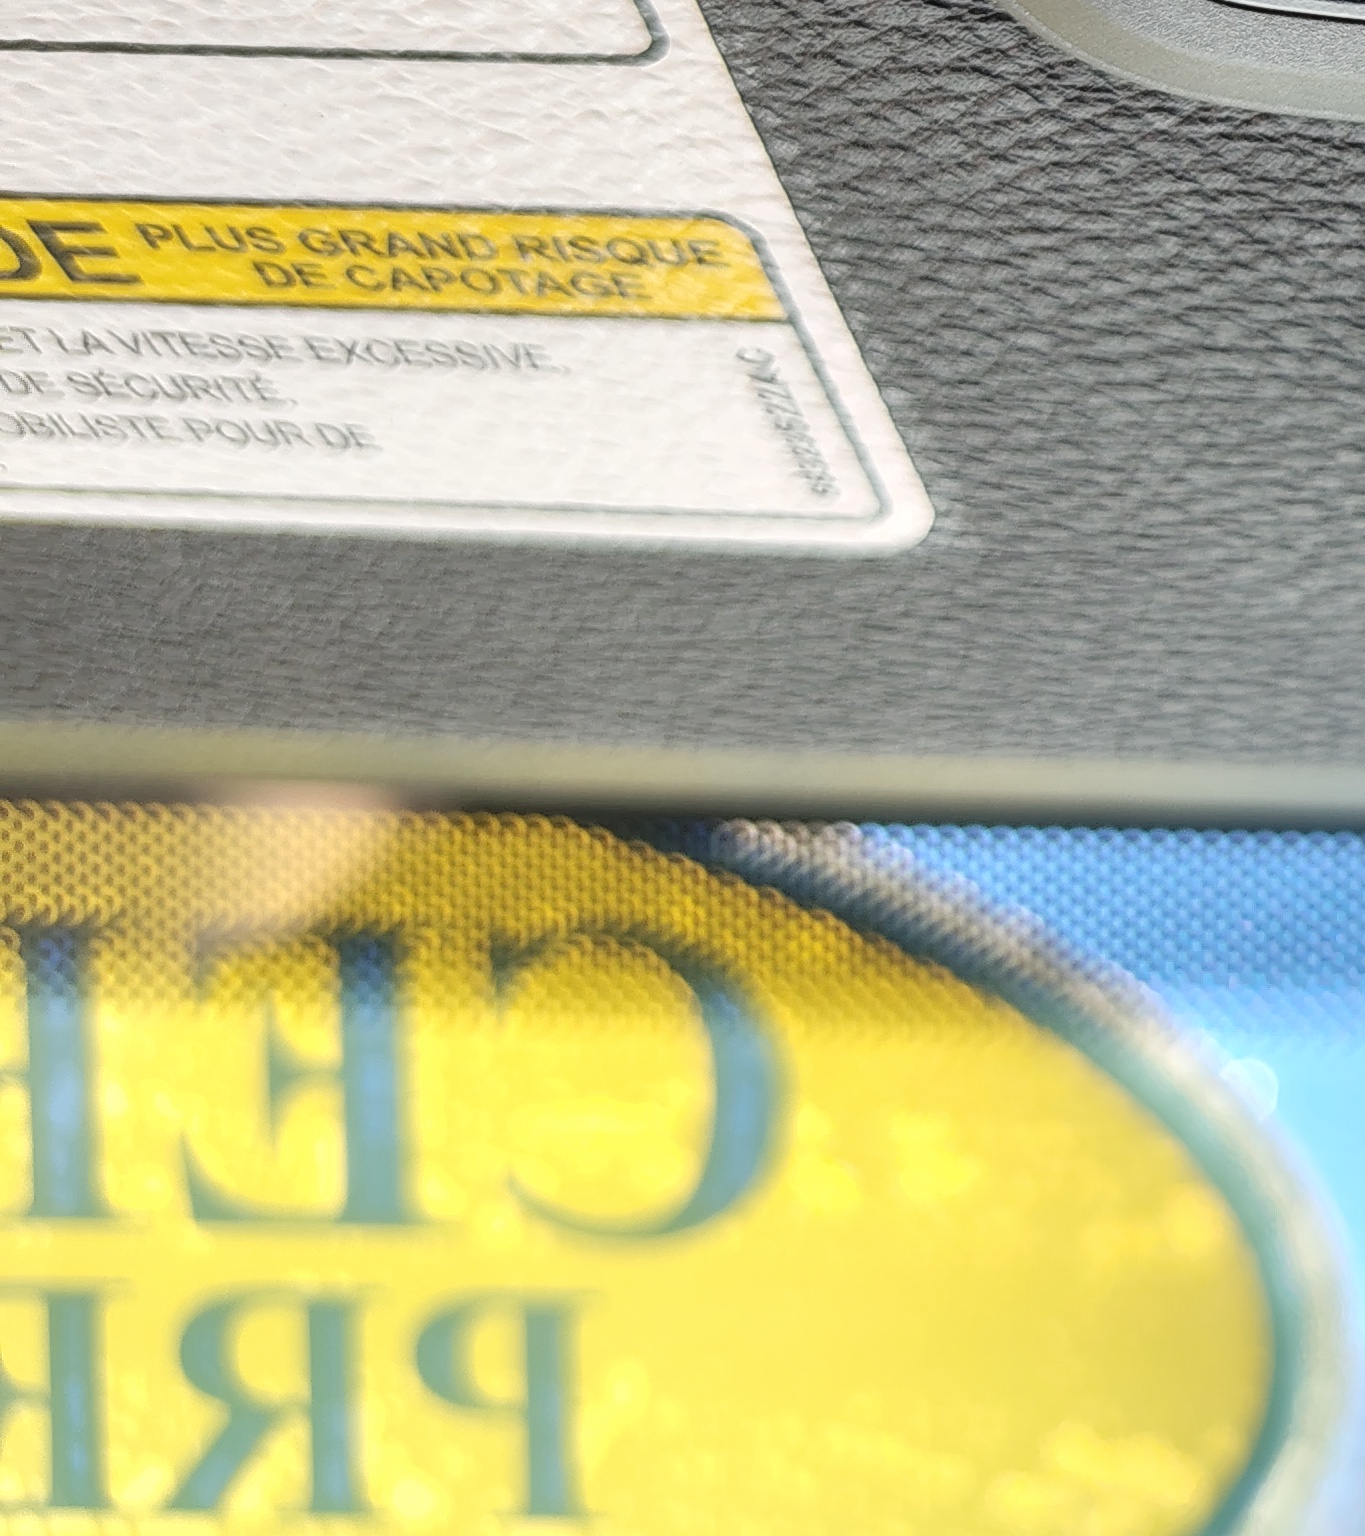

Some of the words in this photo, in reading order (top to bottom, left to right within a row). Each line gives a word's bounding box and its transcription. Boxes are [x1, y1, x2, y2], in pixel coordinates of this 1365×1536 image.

[135, 222, 287, 254] PLUS
[298, 227, 498, 262] GRAND
[511, 233, 729, 268] RISQUE
[252, 261, 335, 289] DE
[345, 264, 652, 300] CAPOTAGE
[47, 327, 117, 356] LA
[106, 329, 302, 364] VITESSE
[180, 415, 313, 450] POUR
[313, 420, 382, 452] DE
